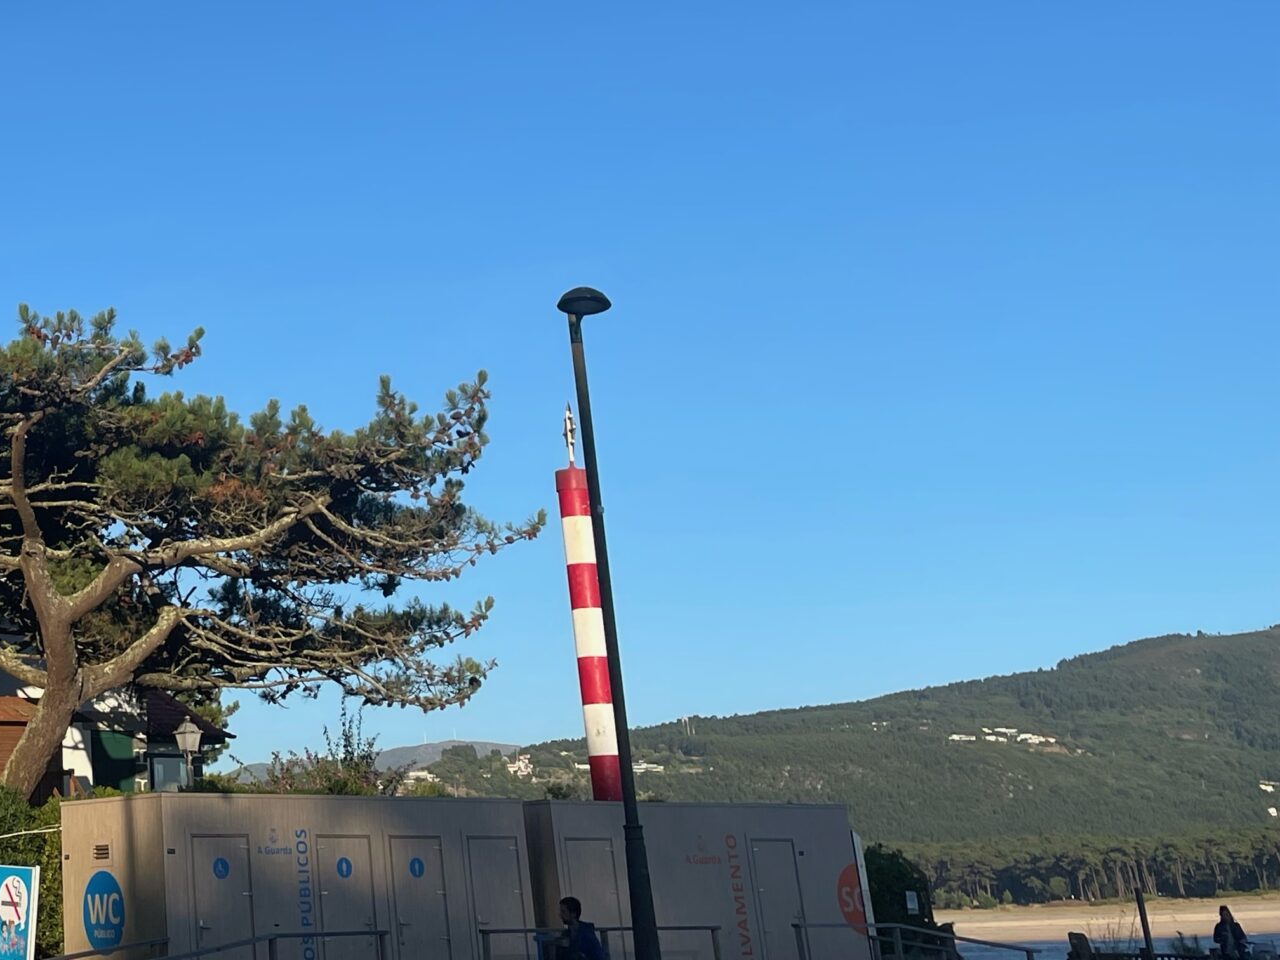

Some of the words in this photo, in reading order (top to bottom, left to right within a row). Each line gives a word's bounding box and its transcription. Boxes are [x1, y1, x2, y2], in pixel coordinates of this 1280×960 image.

[265, 846, 293, 855] Guarda
[295, 828, 313, 928] PÚBLICOS
[87, 893, 121, 925] WC
[725, 833, 754, 958] LVAMENTO
